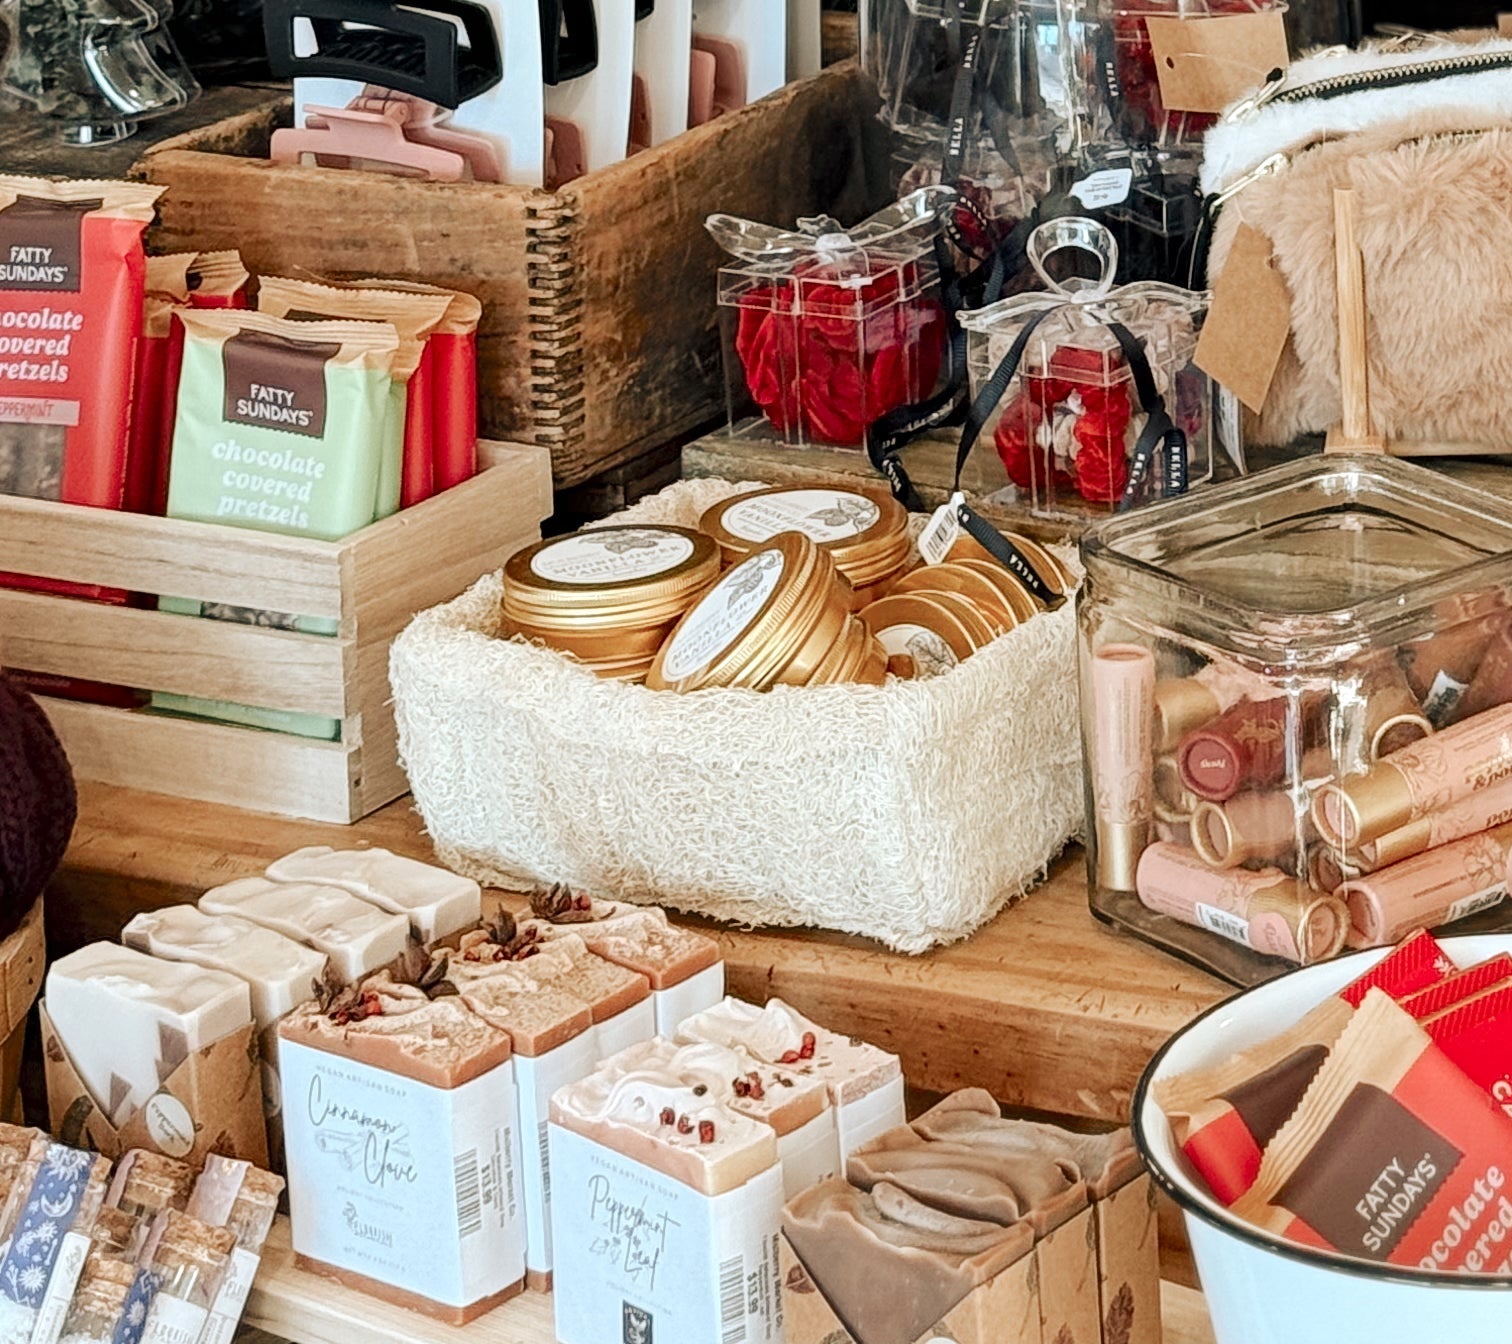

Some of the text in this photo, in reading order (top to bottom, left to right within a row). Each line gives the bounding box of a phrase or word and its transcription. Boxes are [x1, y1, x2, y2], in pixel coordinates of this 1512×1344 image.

[949, 117, 965, 157] BELLA
[10, 245, 52, 265] FATTY
[0, 264, 65, 284] SUNDAYS
[0, 307, 84, 332] ocolate
[0, 333, 71, 357] overed
[0, 359, 69, 384] retzels
[236, 398, 311, 427] SUNDAYS
[250, 382, 295, 408] FATTY
[211, 438, 326, 480] chocolate
[1169, 444, 1183, 491] BELLA
[222, 469, 313, 504] covered
[216, 494, 309, 530] pretzels
[308, 1073, 400, 1134] Cinnamon
[363, 1130, 418, 1190] Clove
[1353, 1155, 1408, 1223] FATTY
[1361, 1157, 1439, 1253] SUNDAYS
[1417, 1164, 1506, 1273] ocolate
